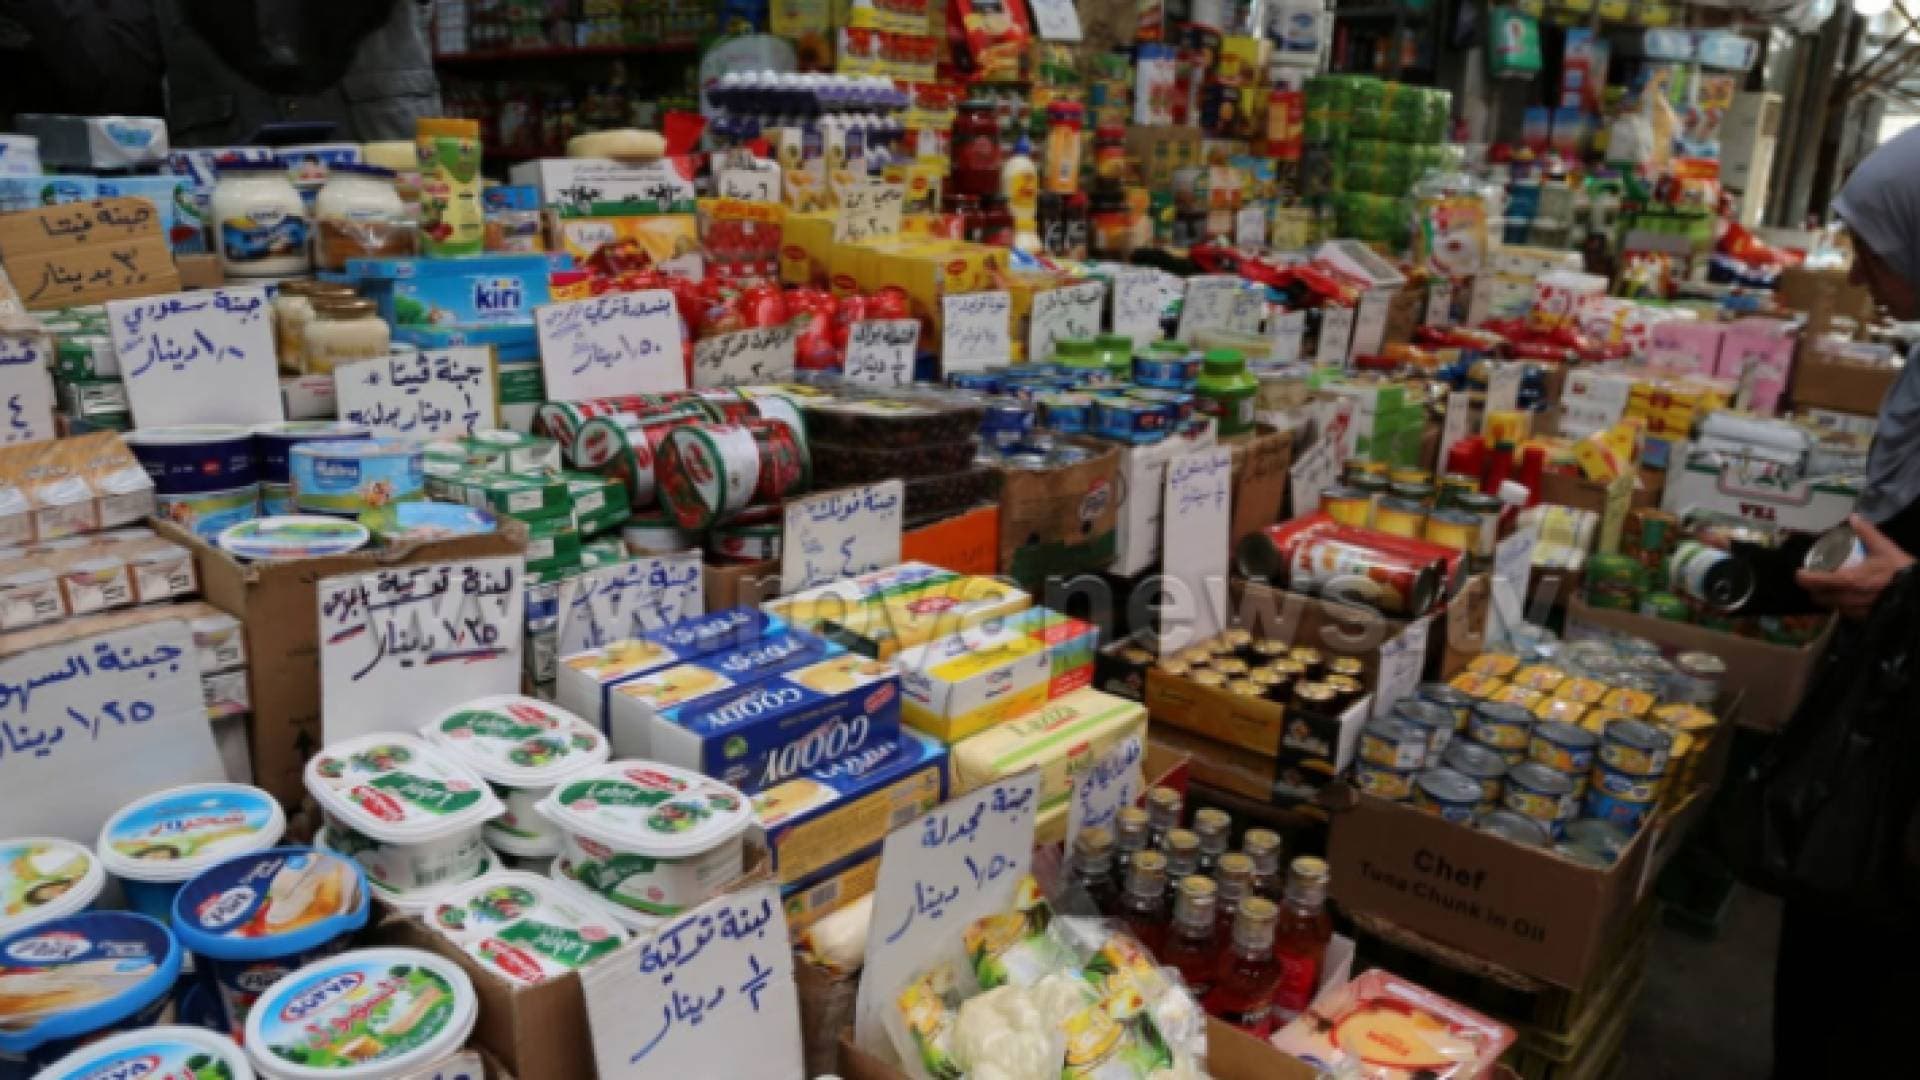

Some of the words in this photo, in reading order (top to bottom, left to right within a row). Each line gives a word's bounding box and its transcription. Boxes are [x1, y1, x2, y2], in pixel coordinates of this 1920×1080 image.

[476, 278, 521, 310] kiri
[131, 332, 198, 378] دينار
[461, 565, 514, 606] لبنة
[94, 641, 183, 679] جبنة
[351, 620, 435, 681] دينار
[990, 785, 1034, 823] جبنة
[1412, 848, 1488, 892] Chef
[720, 899, 773, 940] لبنة
[885, 879, 961, 945] دينار
[1358, 859, 1408, 893] Tuna
[1412, 880, 1482, 920] Chunk
[1512, 916, 1548, 945] Oil
[628, 985, 726, 1065] دينار
